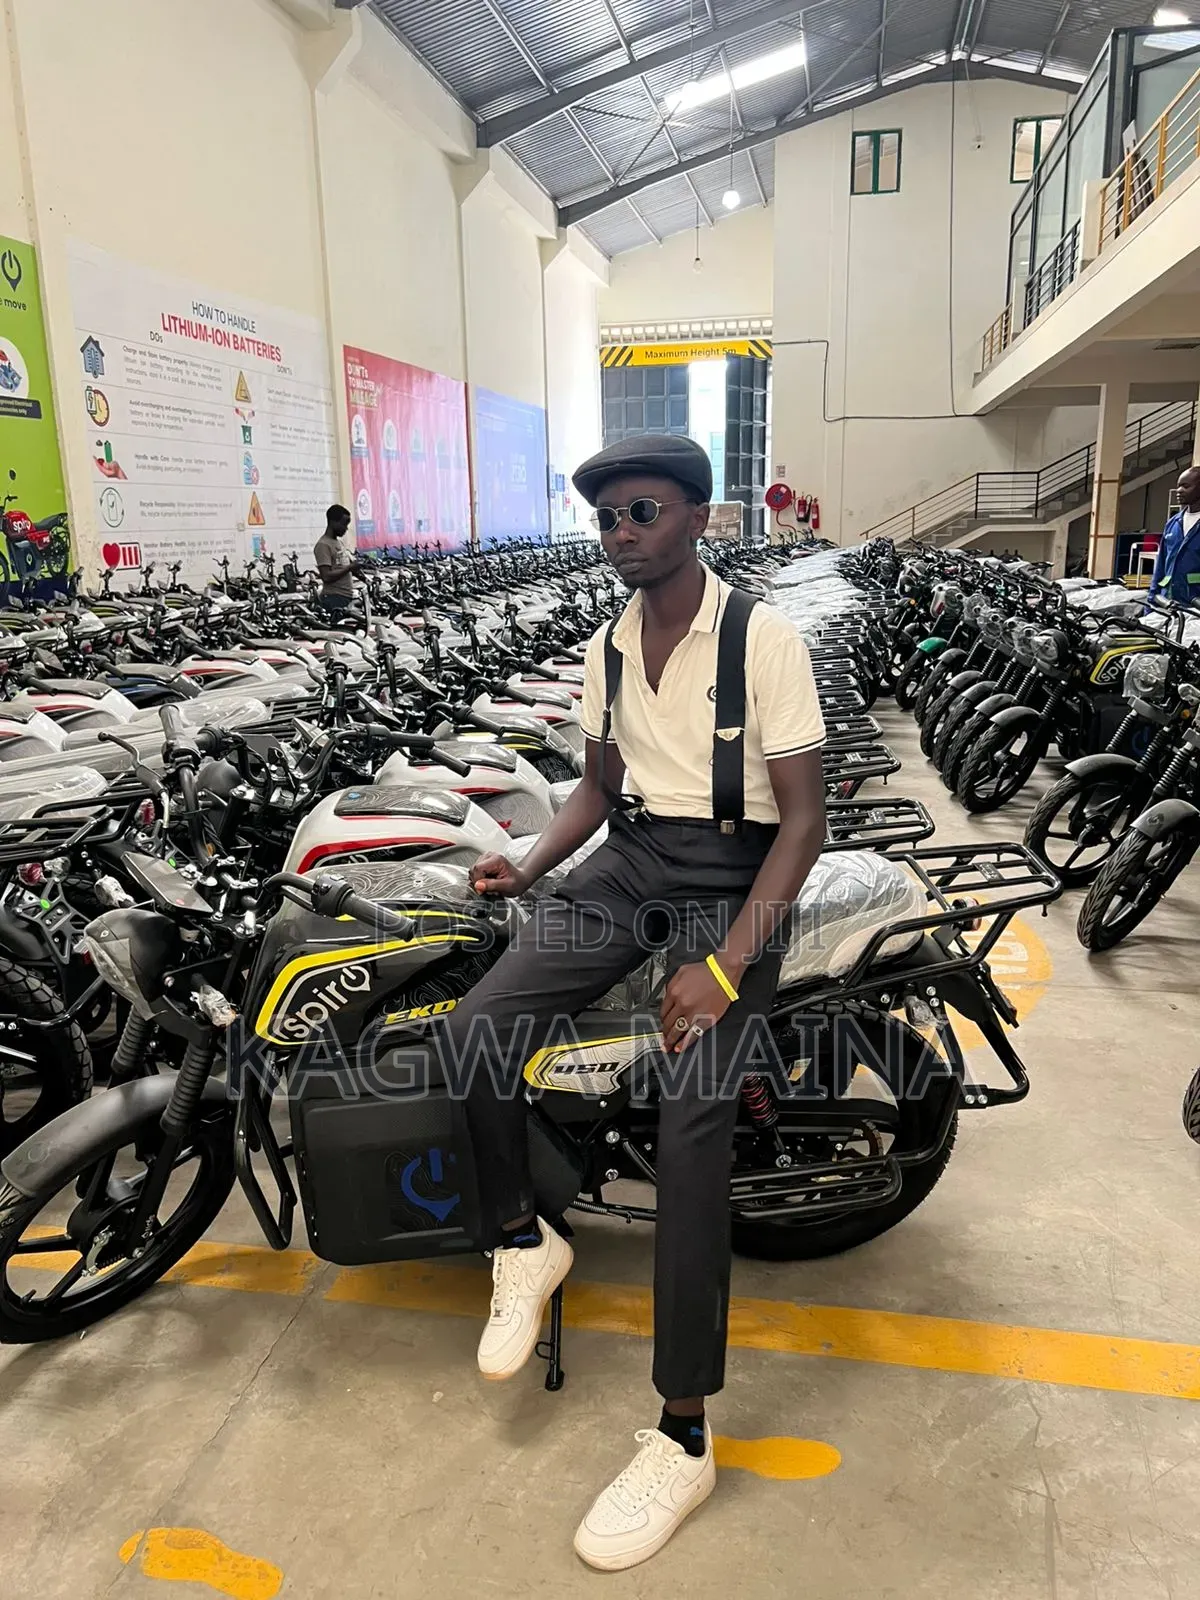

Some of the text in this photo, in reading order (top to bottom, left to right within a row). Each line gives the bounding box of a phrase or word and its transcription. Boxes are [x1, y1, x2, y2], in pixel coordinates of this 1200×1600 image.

[3, 298, 27, 311] move
[191, 301, 256, 334] HOW TO HANDLE
[161, 312, 282, 362] LITHIUM-ION BATTERIES
[645, 350, 688, 359] Maximum
[691, 348, 719, 357] Height
[384, 997, 464, 1025] EKO
